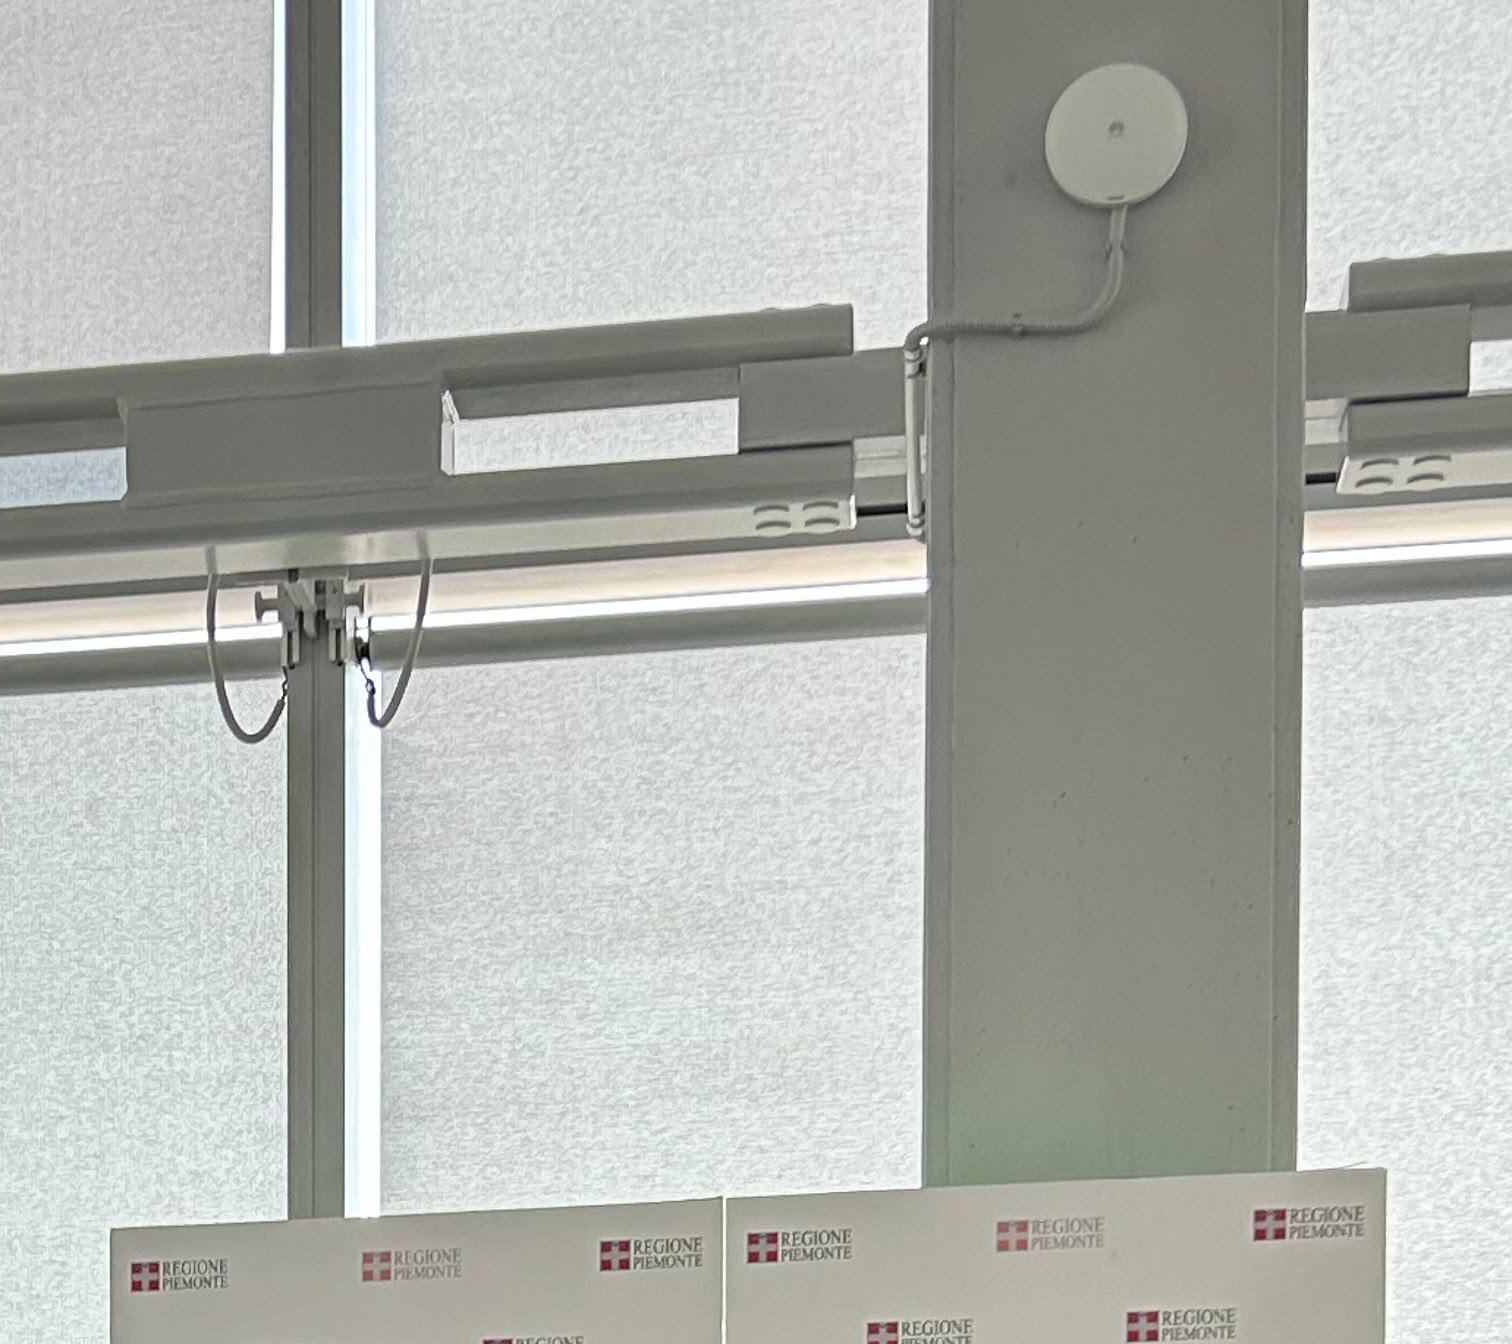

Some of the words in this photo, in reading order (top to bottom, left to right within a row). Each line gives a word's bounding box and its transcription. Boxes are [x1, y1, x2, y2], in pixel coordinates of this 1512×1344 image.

[1288, 1205, 1365, 1224] REGIONE
[1030, 1217, 1105, 1236] REGIONE
[1288, 1222, 1365, 1240] PIEMONTE
[633, 1237, 703, 1255] REGIONE
[781, 1229, 852, 1247] REGIONE
[1030, 1233, 1105, 1251] PIEMONTE
[393, 1249, 462, 1265] REGIONE
[633, 1253, 703, 1270] PIEMONTE
[781, 1245, 852, 1263] PIEMONTE
[163, 1259, 228, 1276] REGIONE
[393, 1264, 462, 1280] PIEMONTE
[163, 1274, 228, 1290] PIEMONTE
[1161, 1308, 1237, 1327] REGIONE
[901, 1319, 973, 1337] REGIONE
[1161, 1324, 1237, 1342] PIEMONTE
